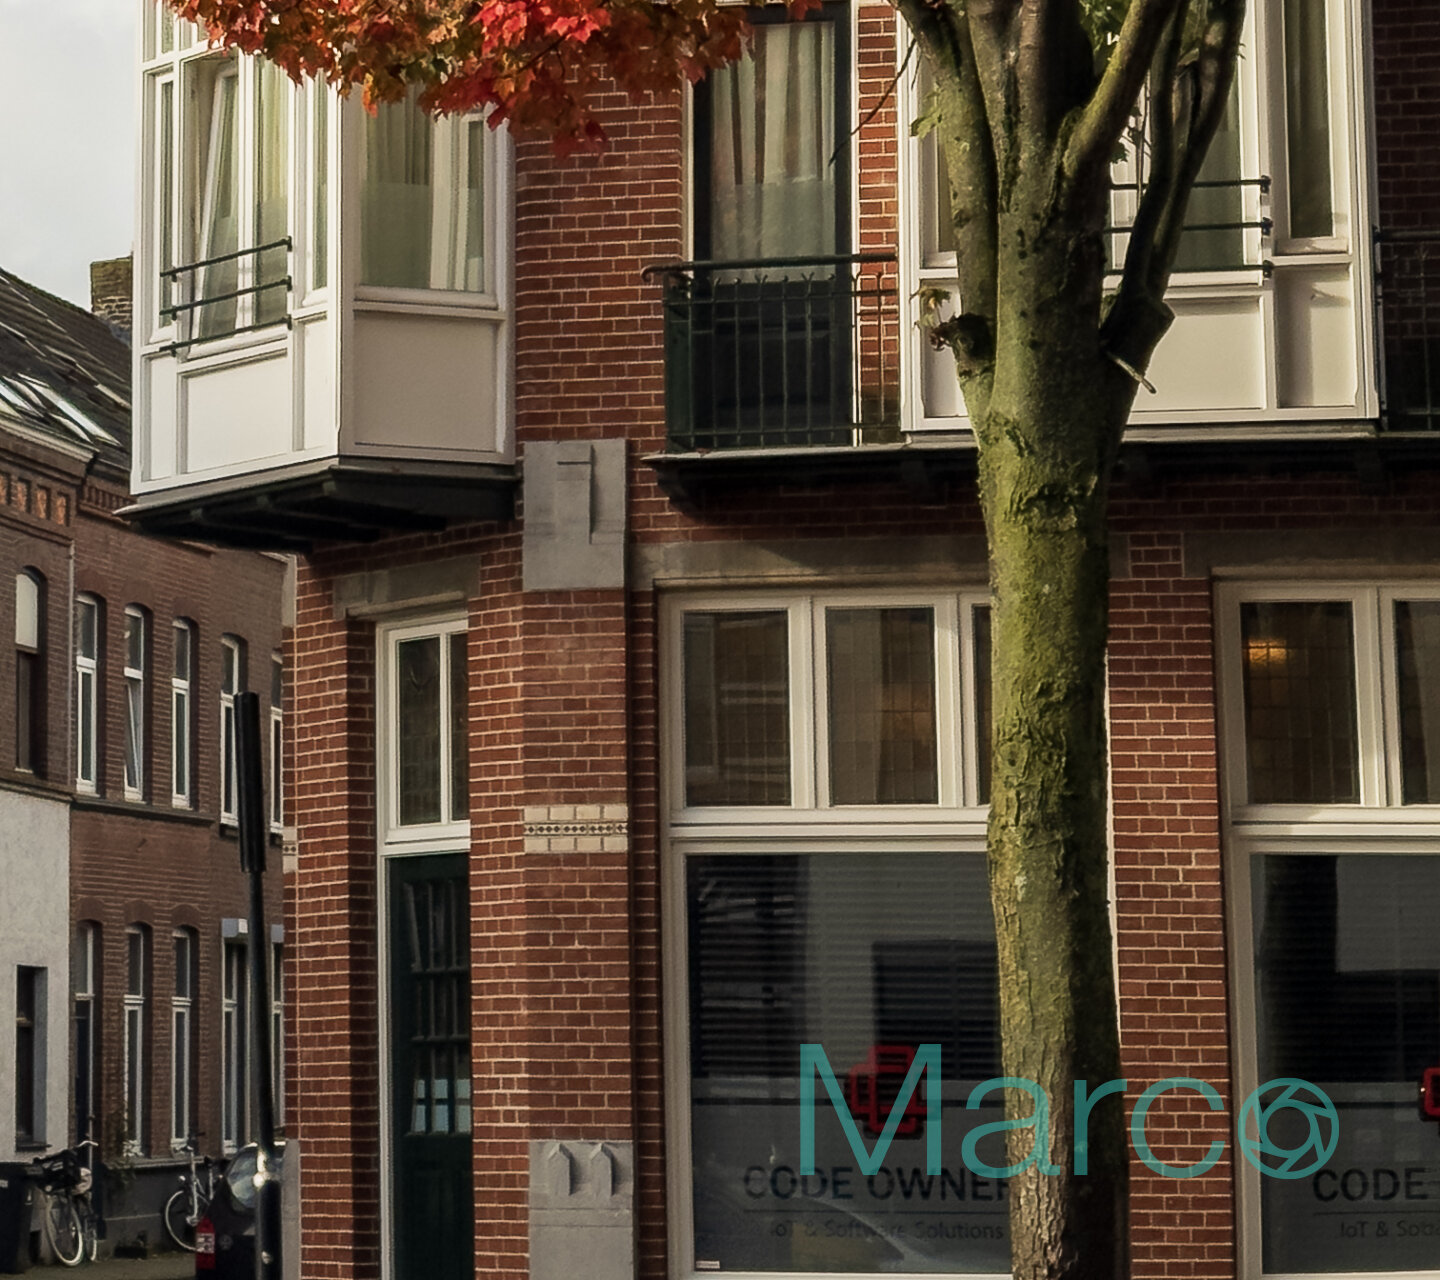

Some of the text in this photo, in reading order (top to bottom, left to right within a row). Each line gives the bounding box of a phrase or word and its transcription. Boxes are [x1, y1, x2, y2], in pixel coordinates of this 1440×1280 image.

[743, 1165, 853, 1200] CODE
[1312, 1168, 1429, 1202] CODE
[824, 1219, 903, 1240] Softwre
[914, 1219, 1005, 1240] Solutions
[1339, 1220, 1369, 1238] IoT
[1375, 1220, 1389, 1238] &
